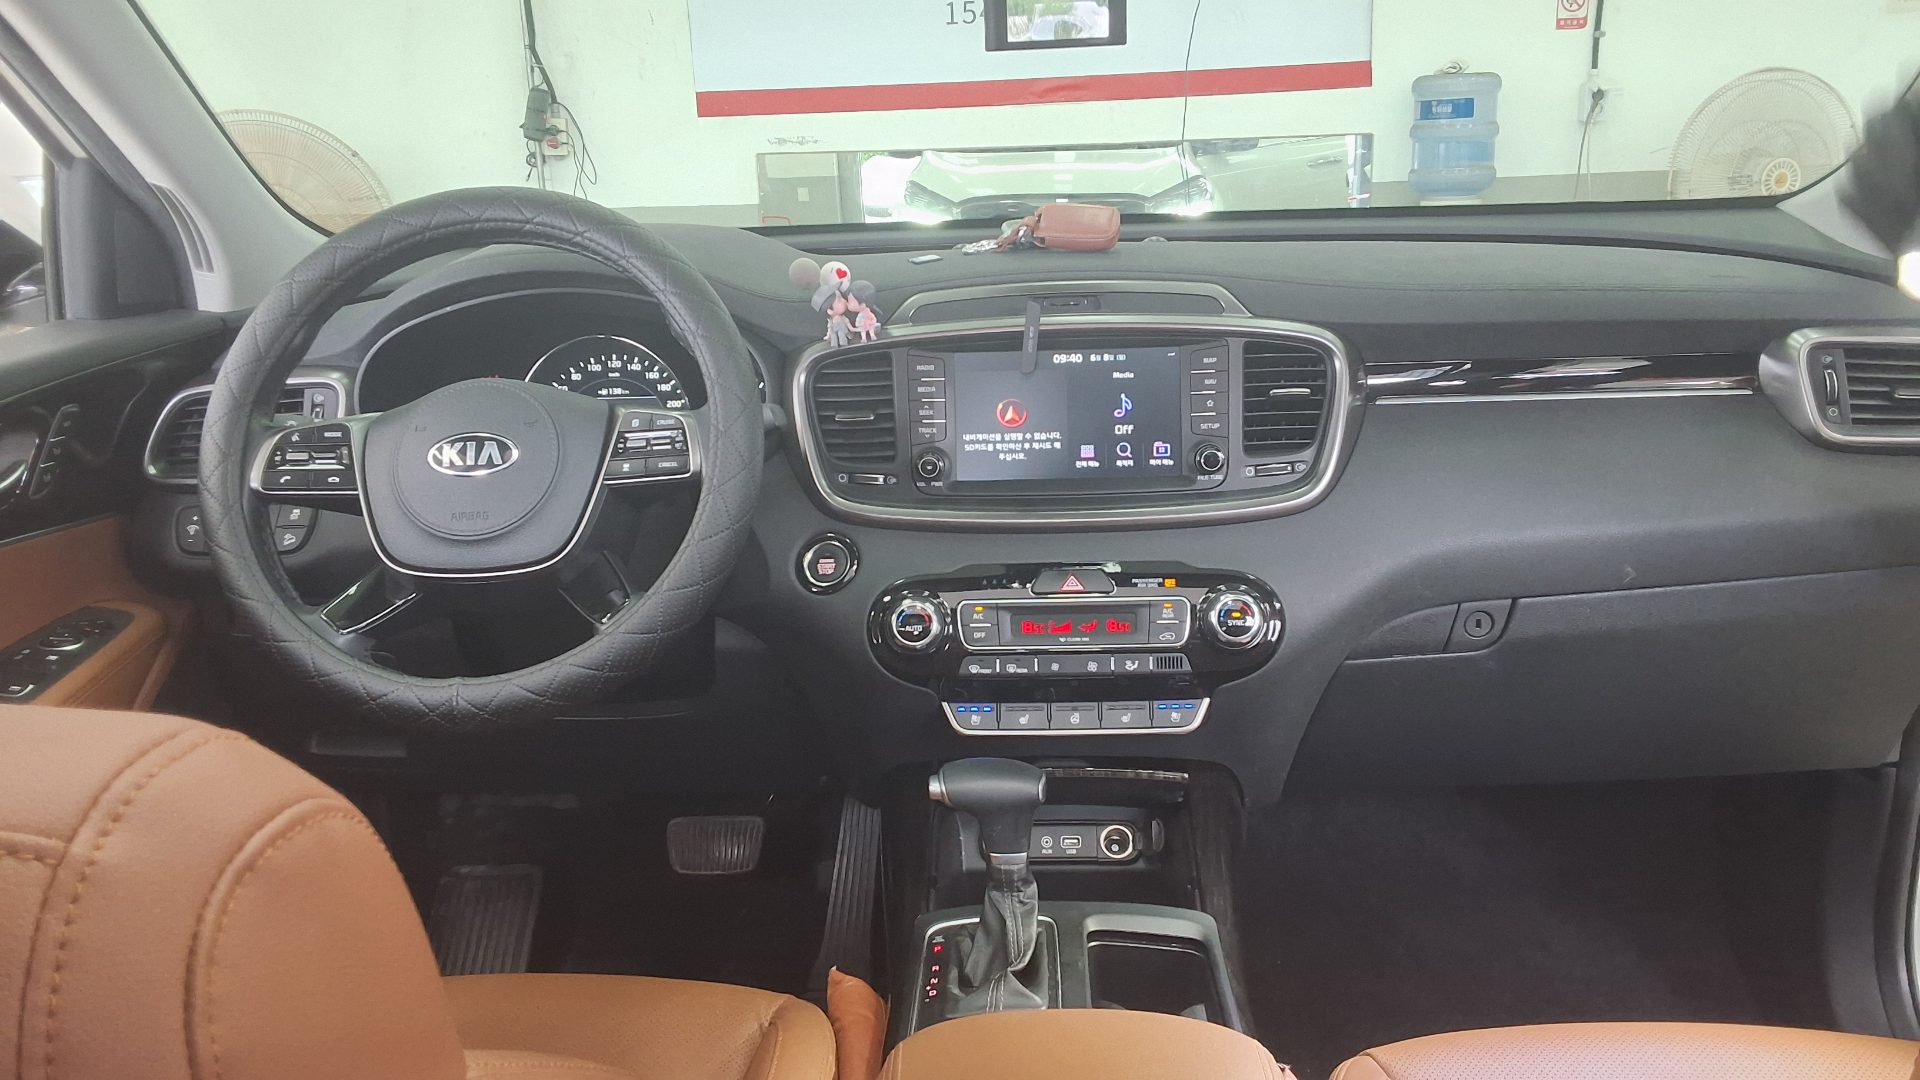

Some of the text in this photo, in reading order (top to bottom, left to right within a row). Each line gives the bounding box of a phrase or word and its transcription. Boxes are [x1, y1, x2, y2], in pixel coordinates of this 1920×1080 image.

[946, 1, 984, 25] 15
[1053, 353, 1083, 363] 09:40
[587, 363, 601, 371] 100
[607, 360, 621, 368] 120
[627, 363, 641, 371] 140
[1112, 371, 1135, 379] Media
[1114, 424, 1134, 435] Off
[442, 441, 503, 467] KIA
[451, 511, 489, 520] AIRBAG
[973, 631, 986, 639] OFF
